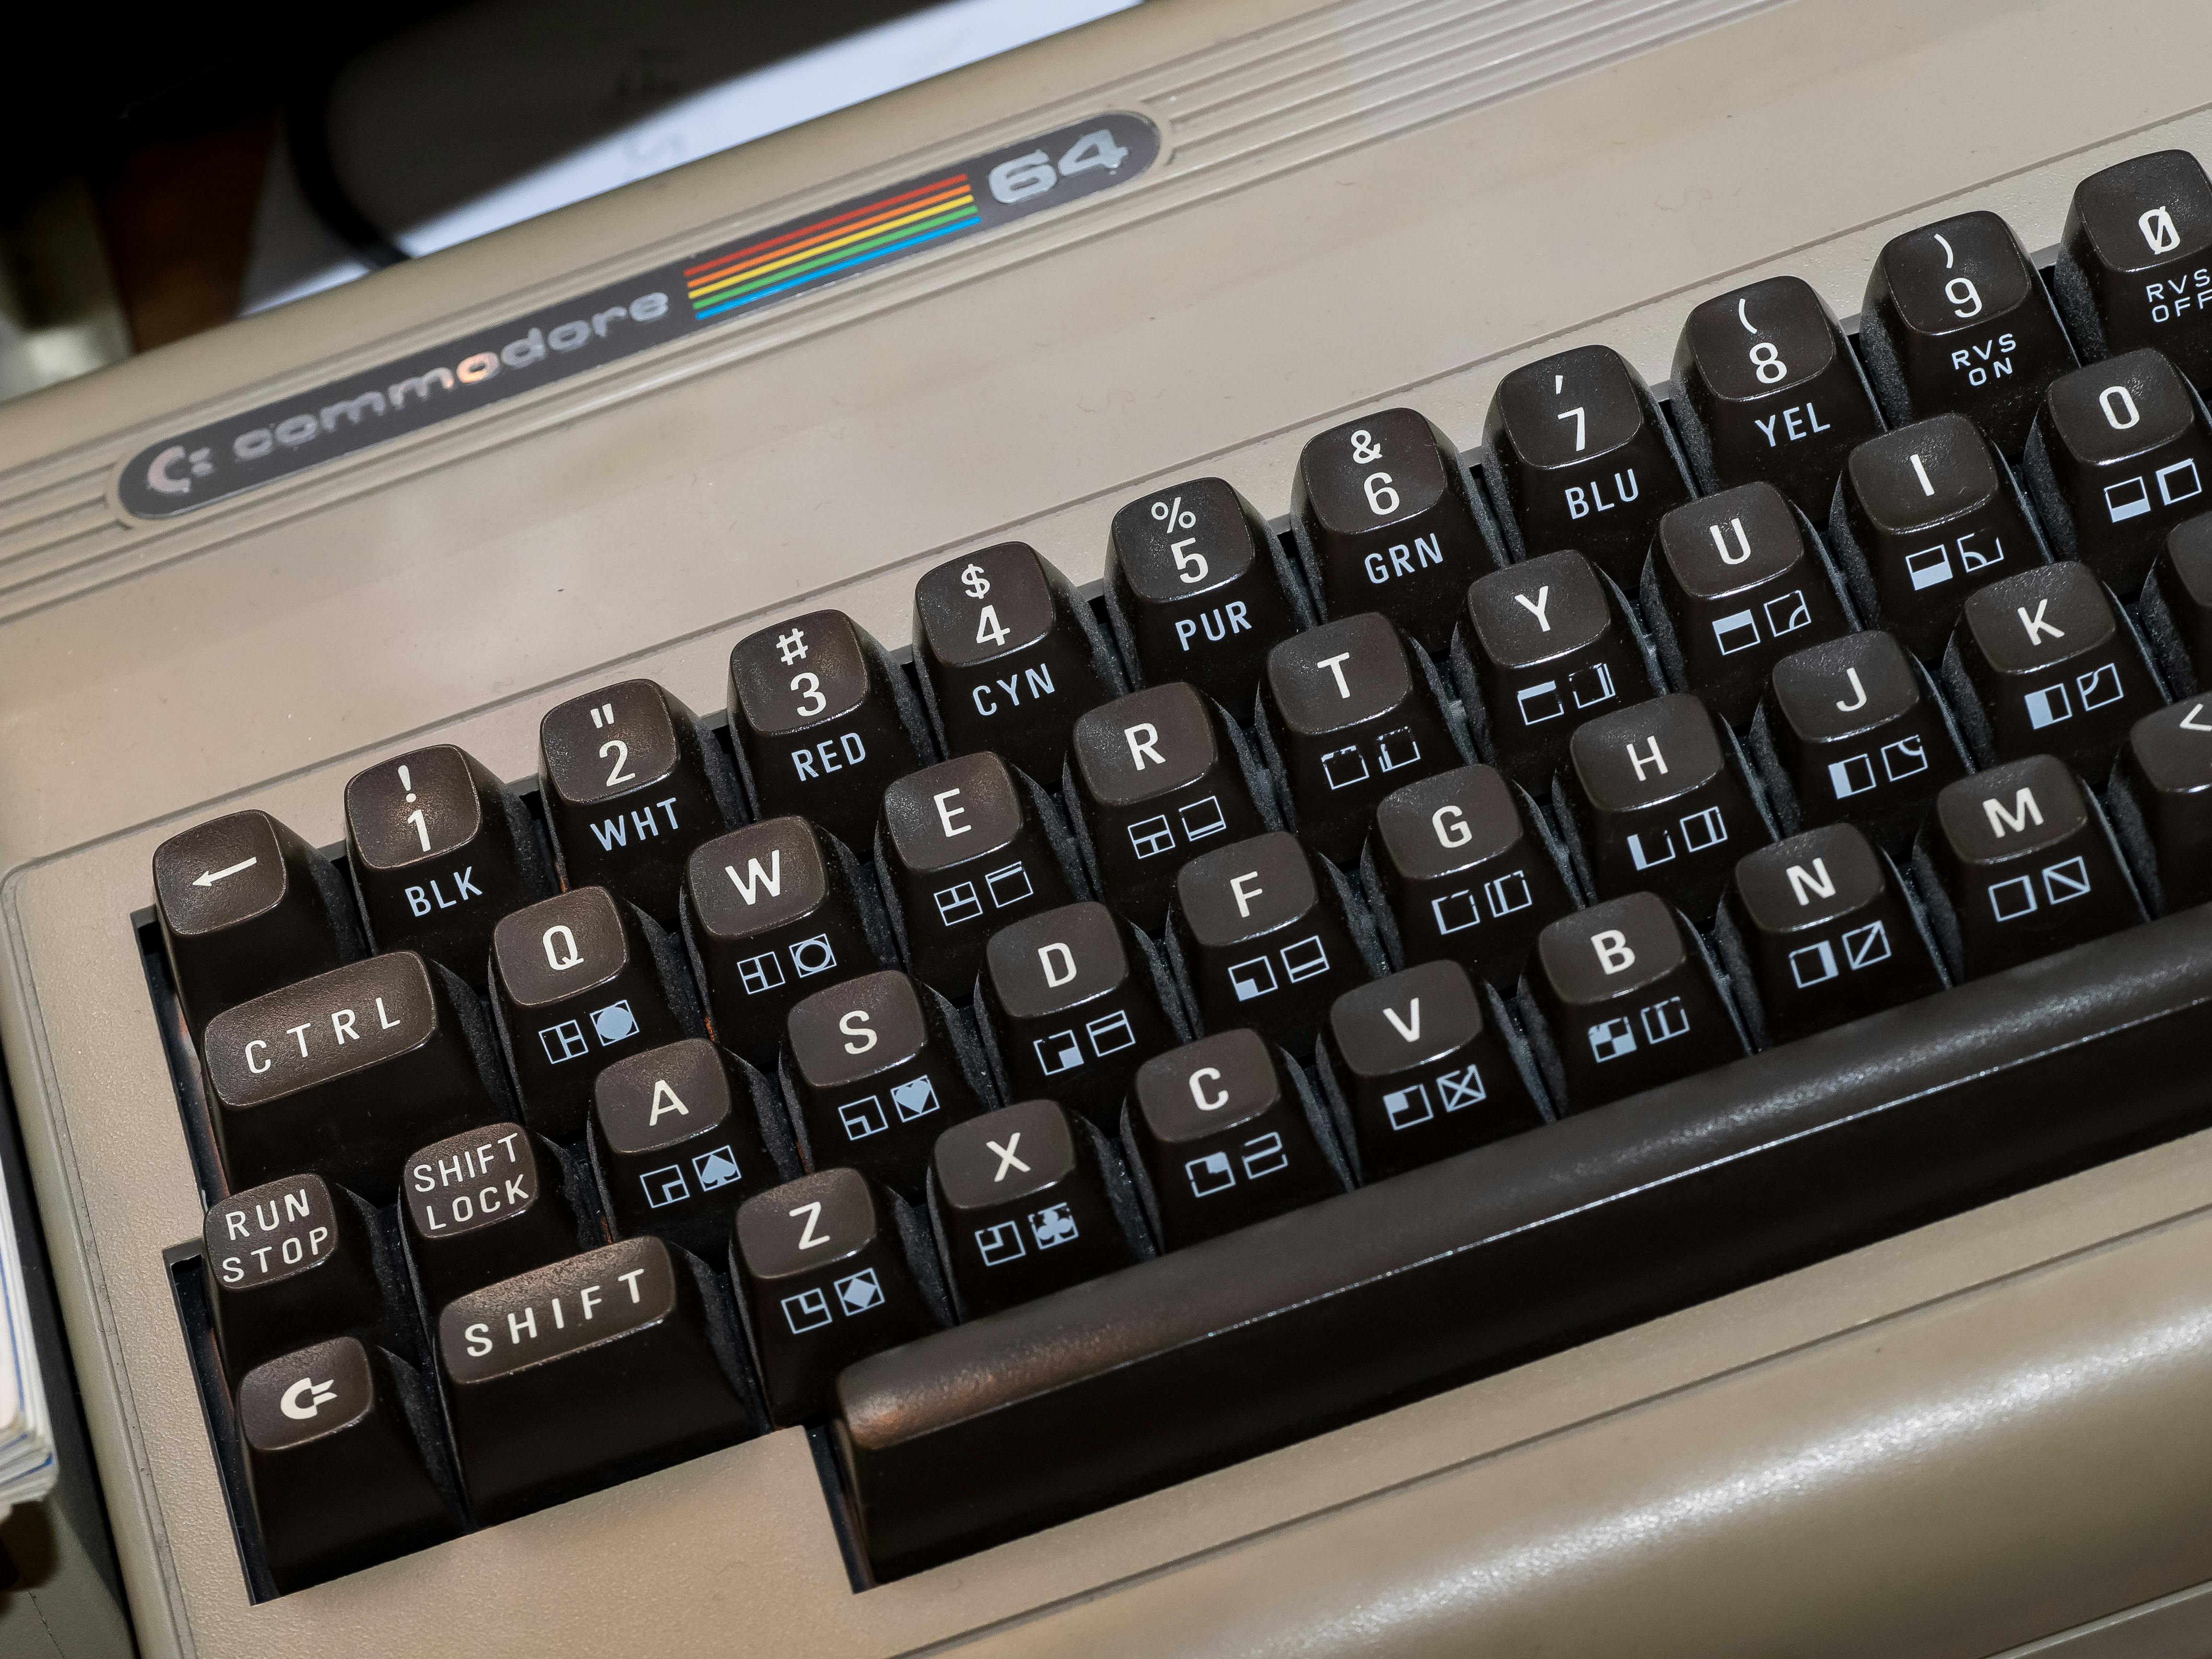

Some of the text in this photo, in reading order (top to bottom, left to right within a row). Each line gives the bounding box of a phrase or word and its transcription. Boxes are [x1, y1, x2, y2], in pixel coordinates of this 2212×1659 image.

[232, 129, 1129, 461] commodore 64
[1944, 277, 1983, 318] 9
[2145, 268, 2211, 303] RVS
[2152, 288, 2212, 323] OFF
[1749, 342, 1788, 384] 8
[1951, 333, 2017, 371] RVS
[1968, 357, 2013, 386] ON
[1557, 406, 1586, 452] 7
[1754, 402, 1831, 448] YEL
[2098, 385, 2140, 430] O
[1363, 471, 1400, 516] 6
[1564, 468, 1639, 520] BLU
[1909, 453, 1936, 497] I
[1170, 537, 1209, 584] 5
[1364, 532, 1443, 584] GRN
[1709, 517, 1752, 565] U
[975, 604, 1011, 647] 4
[1174, 601, 1252, 651] PUR
[1514, 585, 1551, 633] Y
[2017, 598, 2066, 646] K
[790, 672, 827, 717] 3
[972, 662, 1056, 716] CYN
[1316, 651, 1351, 699] T
[1836, 667, 1867, 712] J
[599, 739, 636, 787] 2
[791, 732, 866, 782] RED
[1123, 722, 1166, 771] R
[1625, 735, 1669, 782] H
[407, 808, 432, 853] 1
[589, 797, 679, 852] WHT
[933, 787, 972, 838] E
[1431, 805, 1473, 849] G
[1982, 786, 2044, 839] M
[404, 866, 483, 917] BLK
[724, 849, 781, 906] W
[1229, 870, 1263, 918] F
[1785, 857, 1837, 906] N
[542, 925, 585, 971] Q
[1037, 942, 1078, 988] D
[1590, 929, 1636, 975] B
[244, 997, 401, 1074] CTRL
[839, 1010, 878, 1055] S
[1382, 997, 1420, 1043] V
[649, 1079, 690, 1127] A
[1189, 1067, 1229, 1111] C
[413, 1132, 518, 1192] SHIFT
[986, 1131, 1031, 1183] X
[224, 1188, 310, 1241] RUN
[426, 1173, 529, 1230] LOCK
[788, 1201, 831, 1250] Z
[222, 1226, 328, 1283] STOP
[464, 1268, 645, 1358] SHIFT
